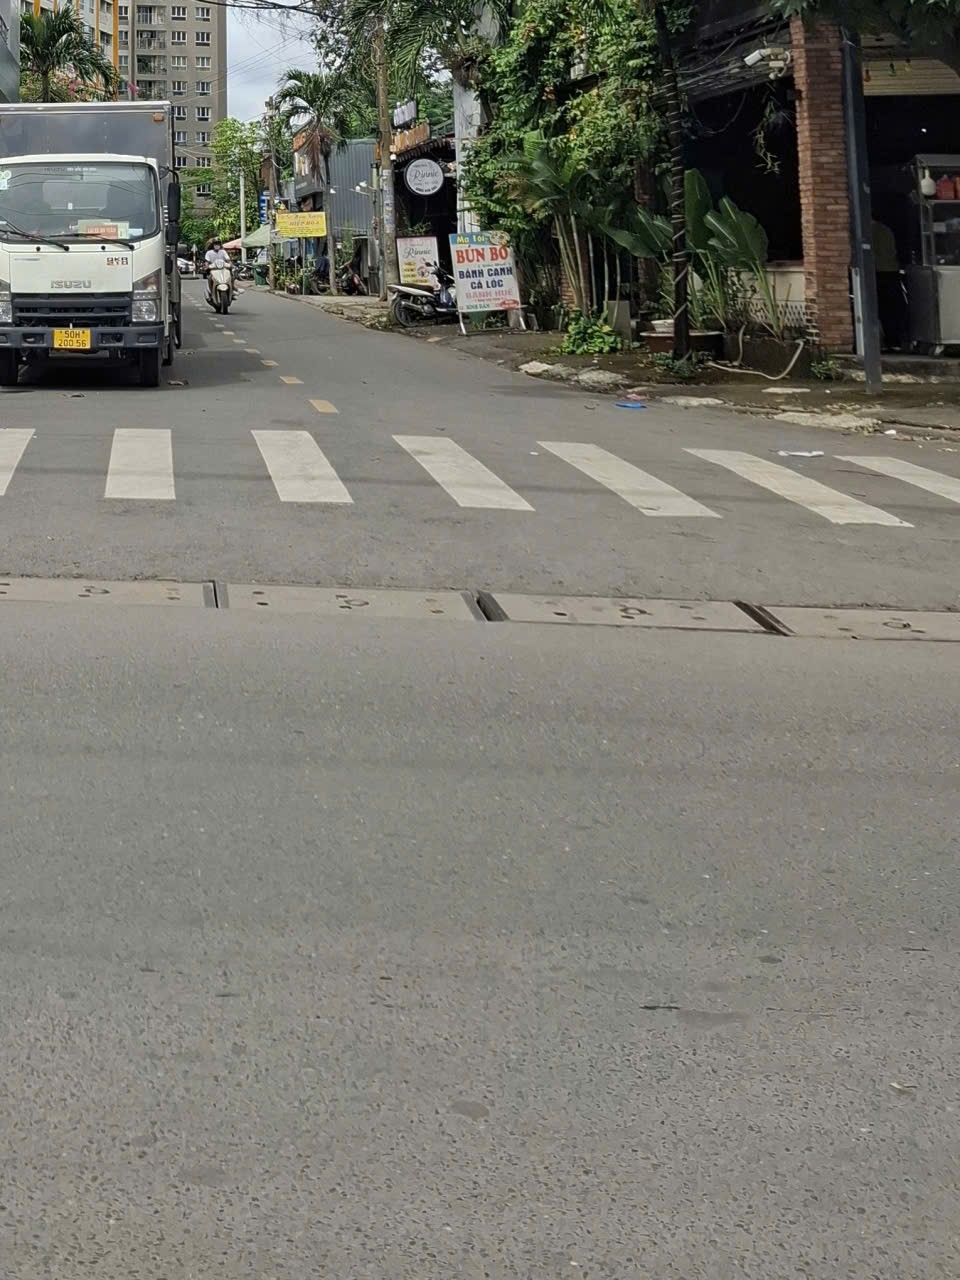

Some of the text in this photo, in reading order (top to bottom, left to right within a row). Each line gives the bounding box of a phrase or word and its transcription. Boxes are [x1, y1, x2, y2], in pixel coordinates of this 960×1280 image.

[456, 244, 486, 264] BÚN
[458, 266, 513, 279] BÁNH CANH
[51, 280, 91, 289] ISUZU
[64, 330, 81, 339] 50H
